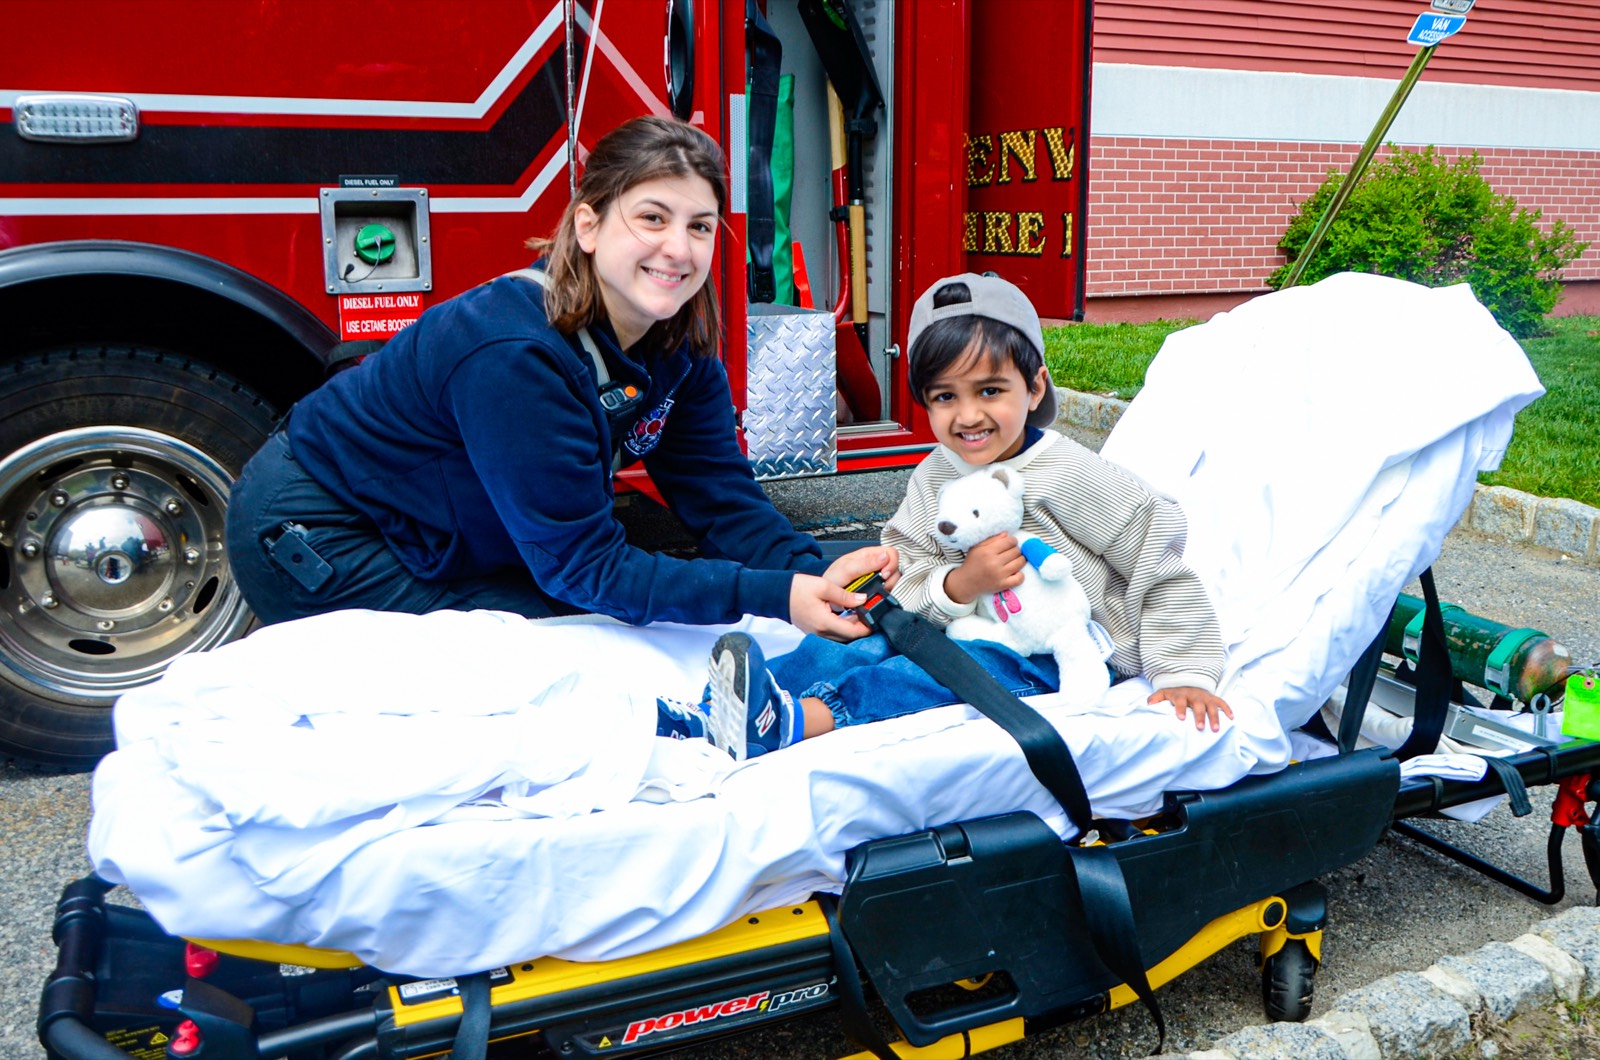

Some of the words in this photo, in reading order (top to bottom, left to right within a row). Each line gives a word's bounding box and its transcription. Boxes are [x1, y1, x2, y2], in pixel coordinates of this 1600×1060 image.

[1432, 17, 1451, 31] VAN
[343, 297, 373, 310] DIESEL
[374, 296, 396, 309] FUEL
[396, 295, 419, 308] ONLY
[346, 320, 360, 333] USE
[360, 318, 387, 333] CETANE
[621, 990, 770, 1045] power
[768, 983, 829, 1012] pro
